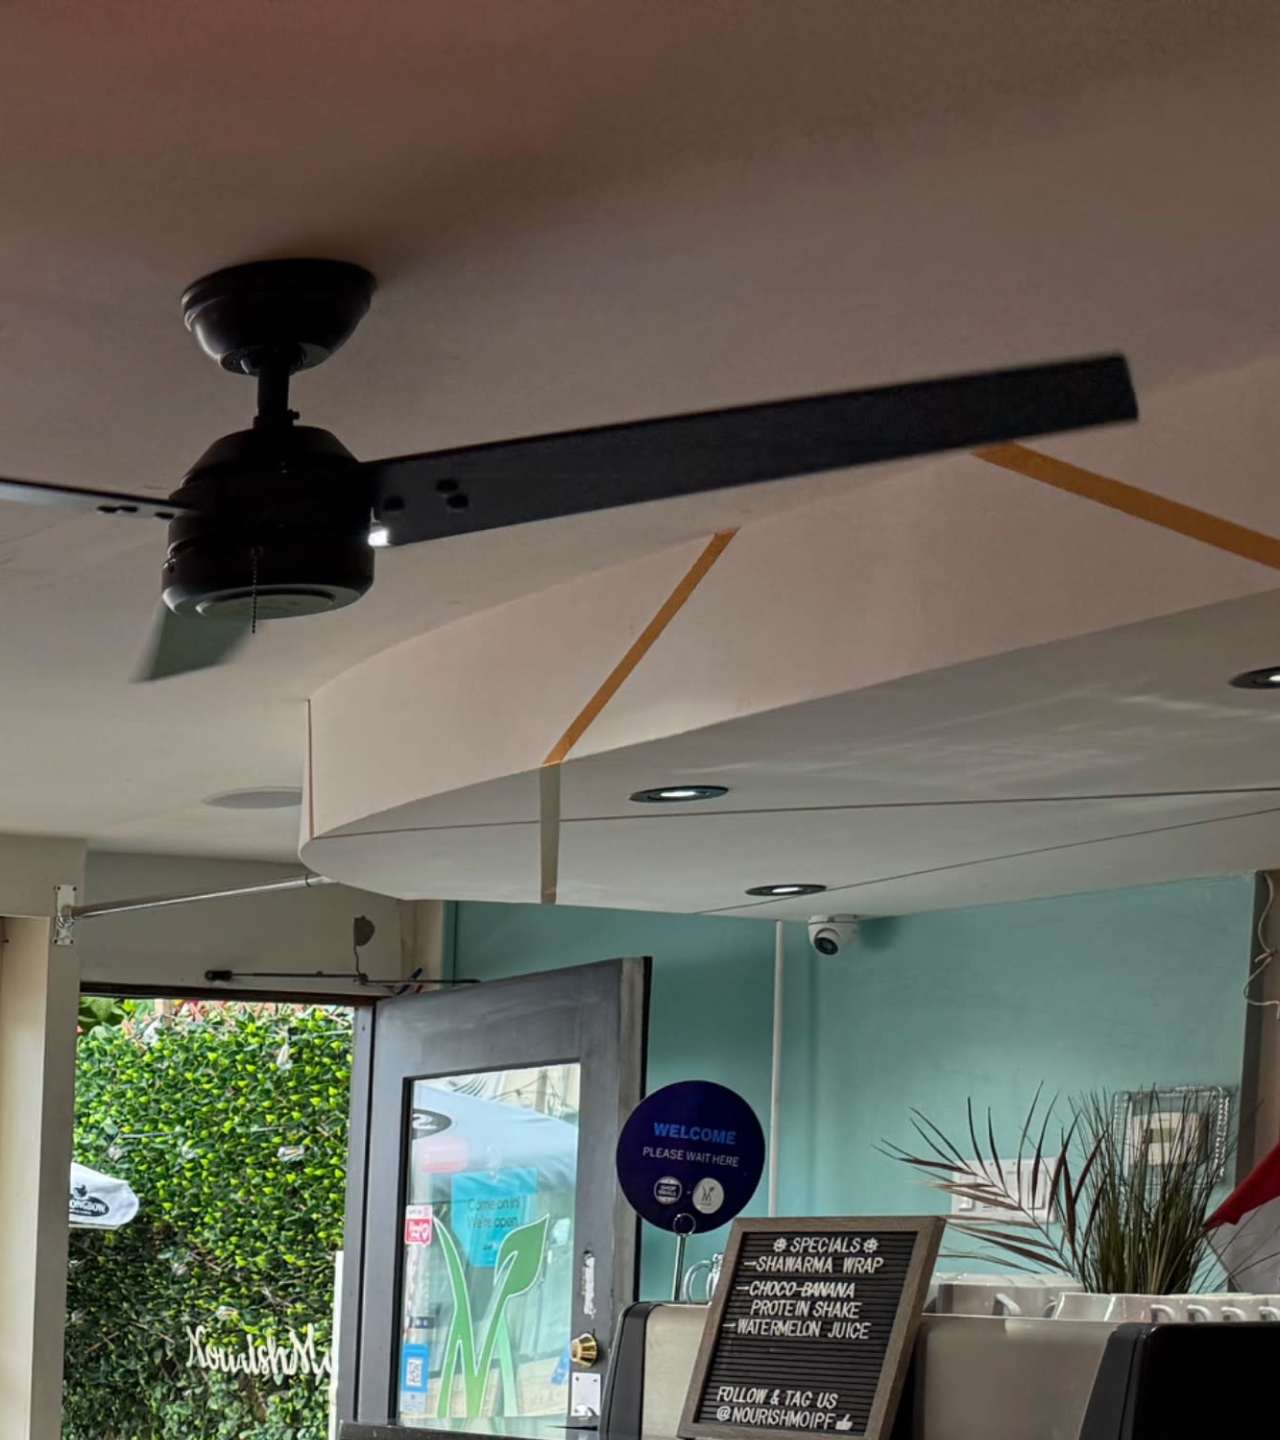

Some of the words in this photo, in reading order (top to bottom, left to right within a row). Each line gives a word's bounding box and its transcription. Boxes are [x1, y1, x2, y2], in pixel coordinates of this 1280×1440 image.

[653, 1122, 737, 1145] WELCOME
[642, 1146, 684, 1161] PLEASE
[686, 1151, 710, 1164] WAIT
[711, 1155, 740, 1168] HERE
[790, 1237, 861, 1254] SPECIALS
[843, 1256, 884, 1274] WRAP
[750, 1299, 811, 1317] PROTEIN
[813, 1301, 862, 1319] SHAKE
[828, 1321, 872, 1340] JUICE
[716, 1386, 768, 1403] FOLLOW
[770, 1388, 781, 1405] &
[816, 1391, 839, 1410] US
